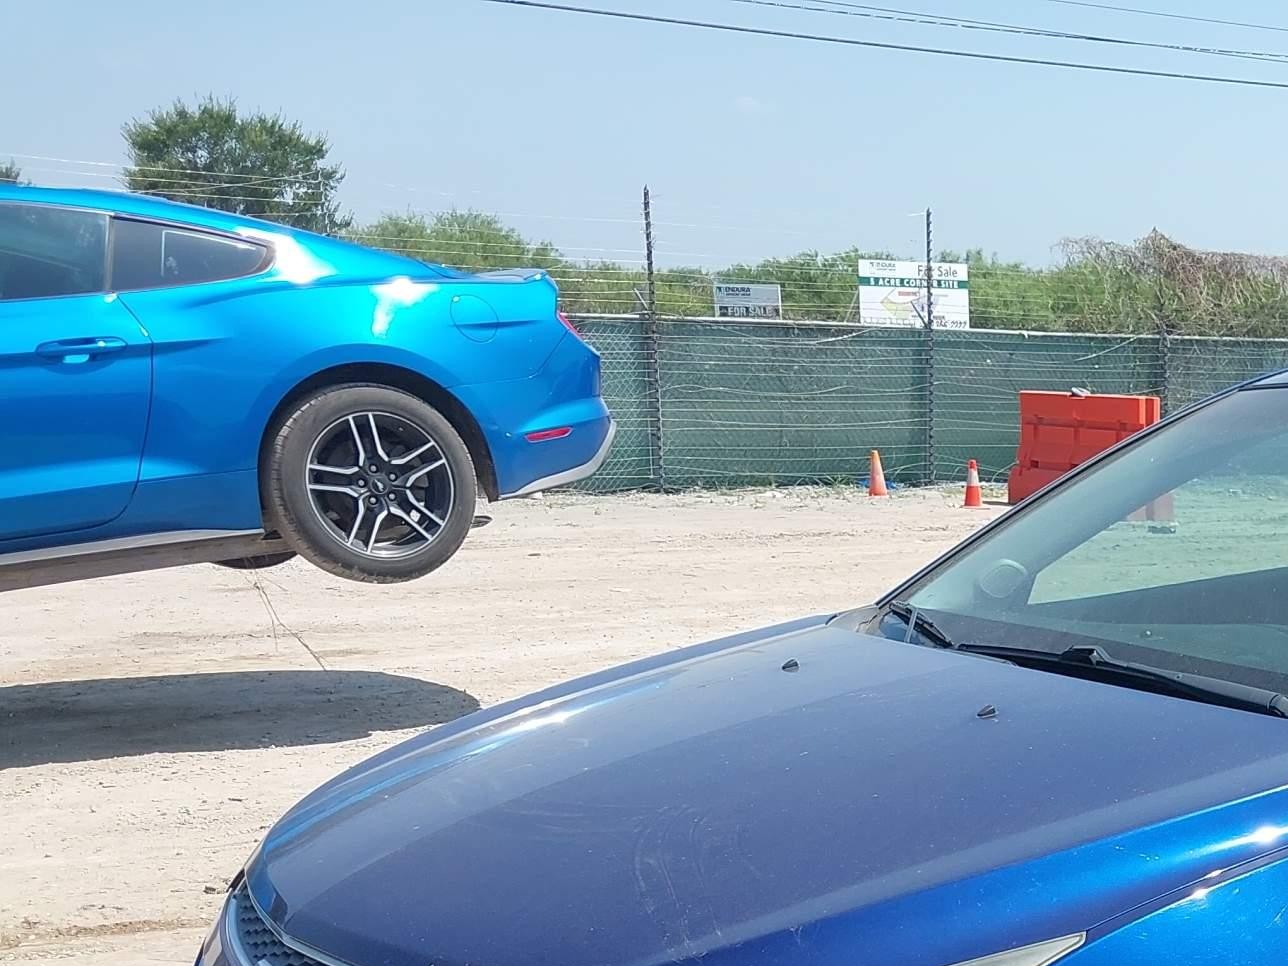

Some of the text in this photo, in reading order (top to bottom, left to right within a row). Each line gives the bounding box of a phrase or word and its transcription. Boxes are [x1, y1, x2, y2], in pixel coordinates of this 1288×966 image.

[937, 266, 958, 278] Sale
[878, 278, 901, 287] ACRE
[903, 279, 938, 288] CORNR
[940, 280, 959, 289] SITE
[728, 306, 746, 316] FOR
[748, 306, 773, 317] SALE
